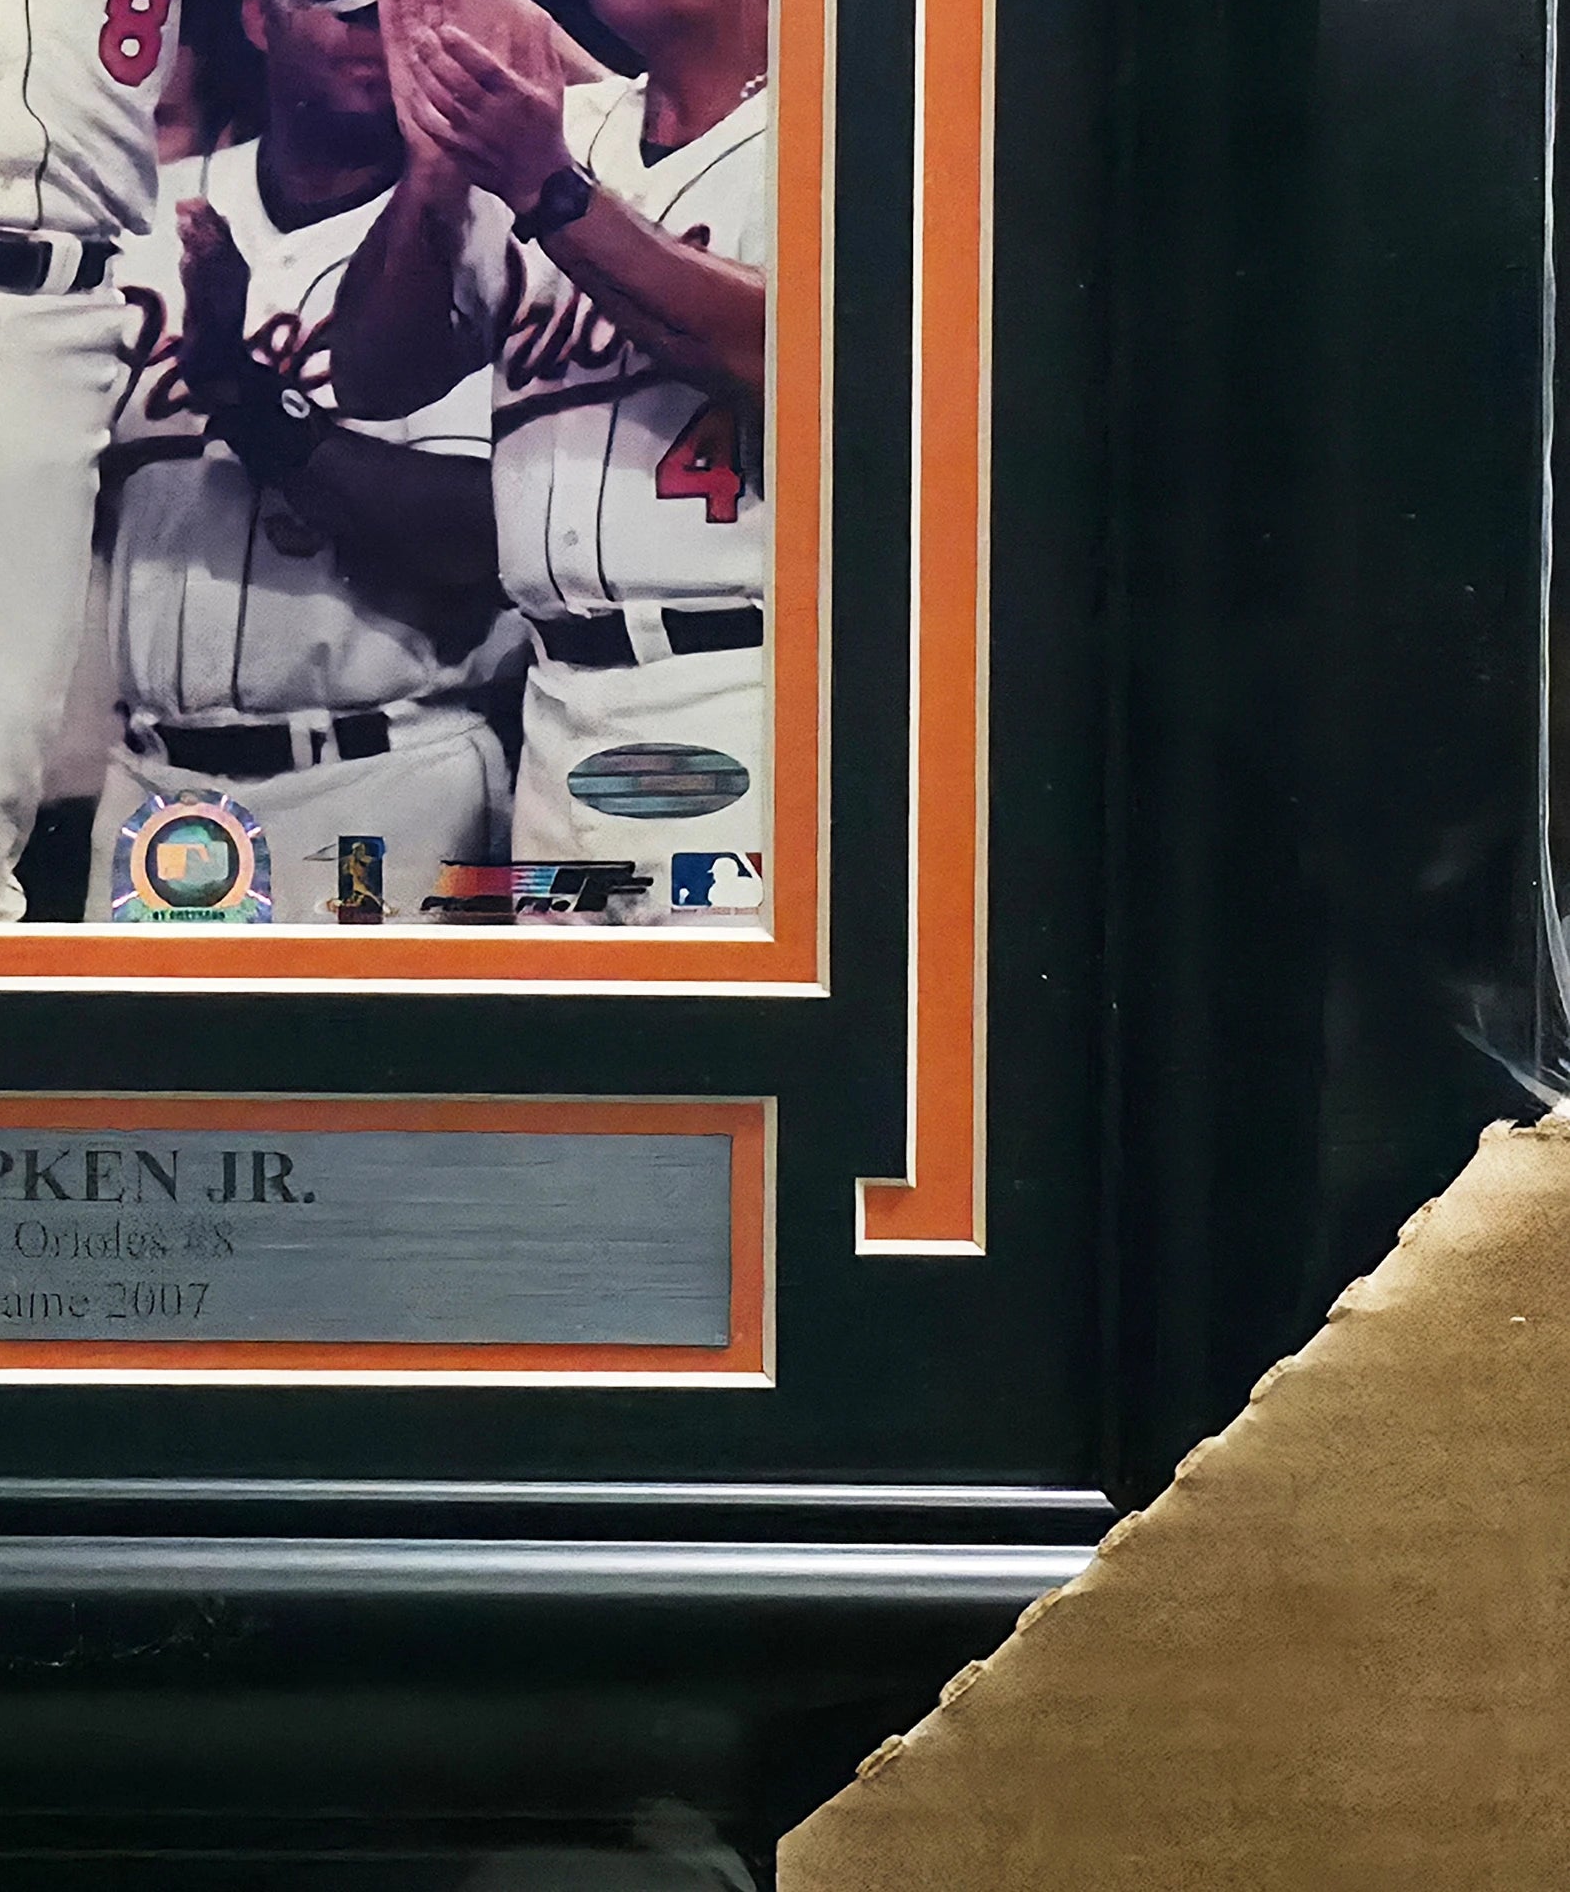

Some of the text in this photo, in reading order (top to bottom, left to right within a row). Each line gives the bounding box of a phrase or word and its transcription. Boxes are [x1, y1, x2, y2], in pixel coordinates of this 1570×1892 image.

[656, 402, 745, 523] 4
[206, 1149, 316, 1205] JR.
[105, 1280, 211, 1319] 2007
